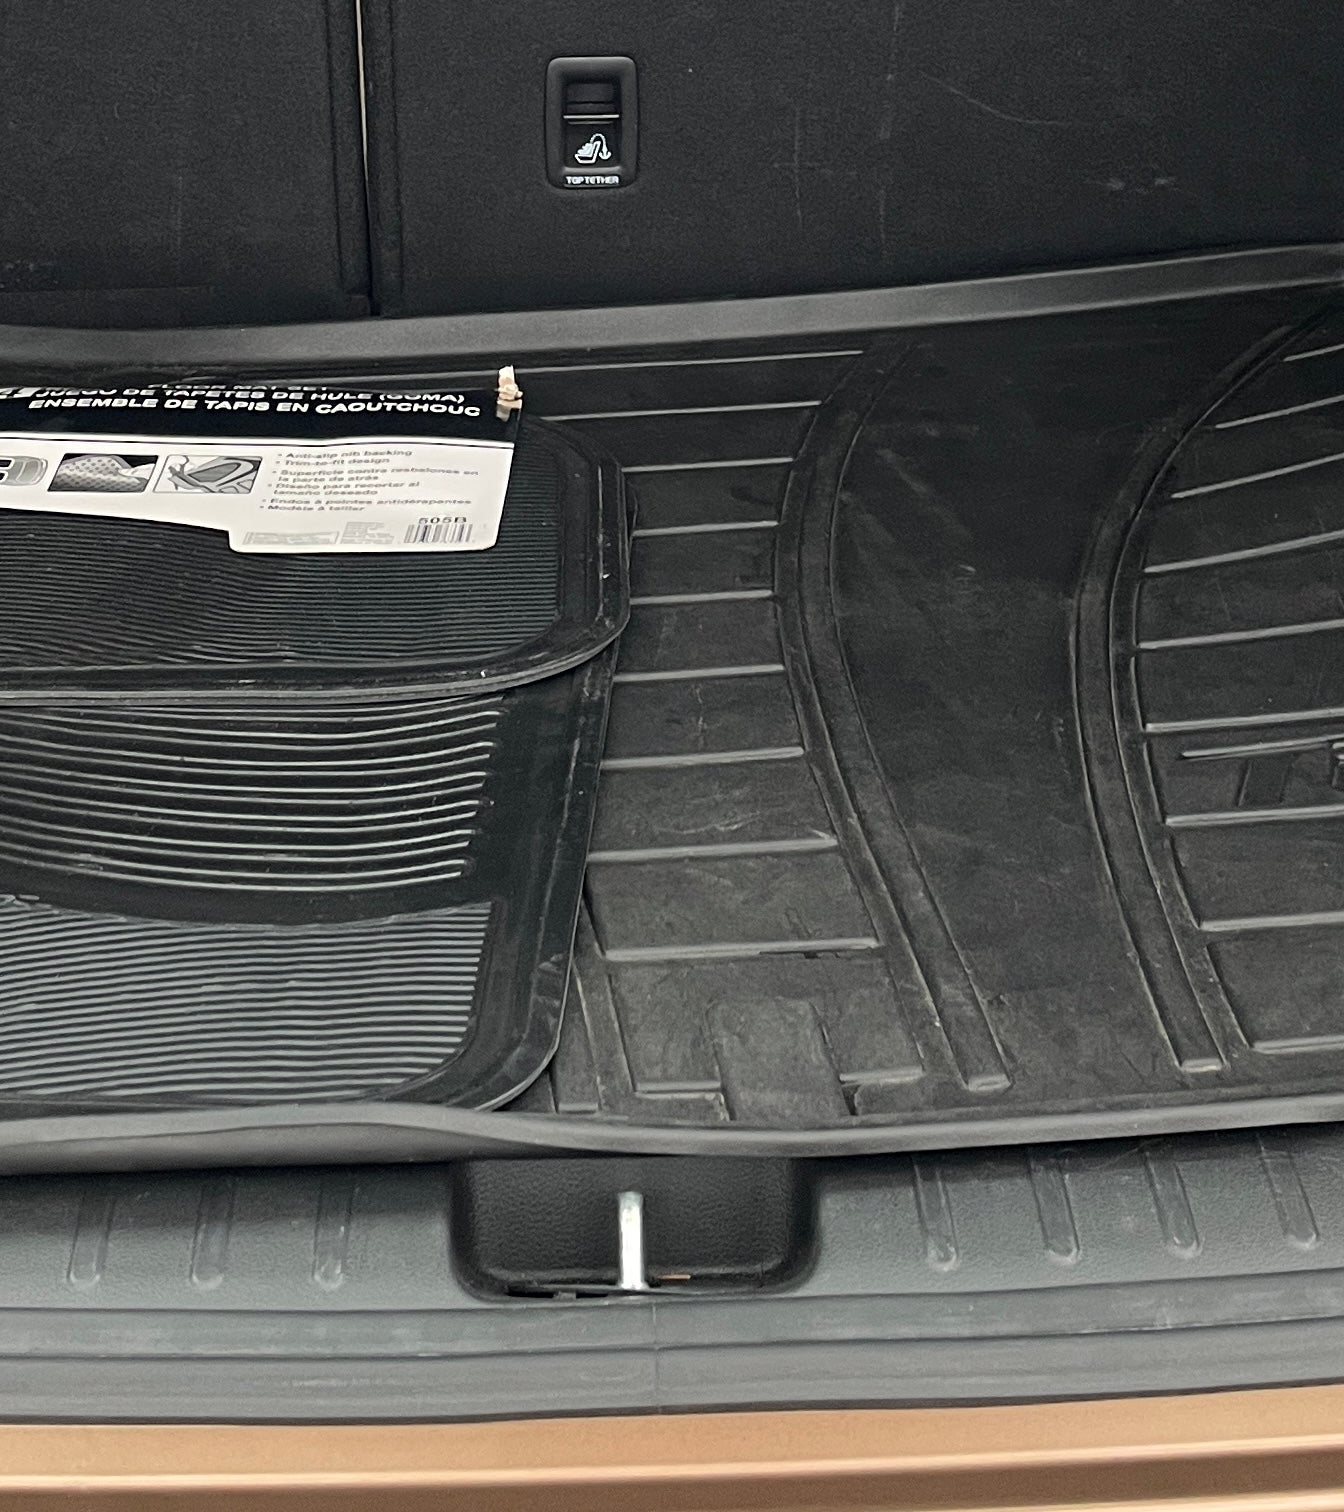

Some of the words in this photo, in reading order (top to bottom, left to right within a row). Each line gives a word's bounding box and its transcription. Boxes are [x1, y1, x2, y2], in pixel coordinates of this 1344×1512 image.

[566, 176, 584, 184] TOP
[585, 175, 619, 184] TETHER
[123, 388, 156, 397] DE
[164, 389, 266, 399] TAPETES
[271, 390, 305, 400] DE
[310, 391, 373, 401] HULE
[28, 398, 158, 409] ENSEMBLE
[164, 399, 198, 410] DE
[205, 399, 270, 411] TAPIS
[276, 402, 309, 412] EN
[315, 401, 481, 416] CAOUTCHOUC
